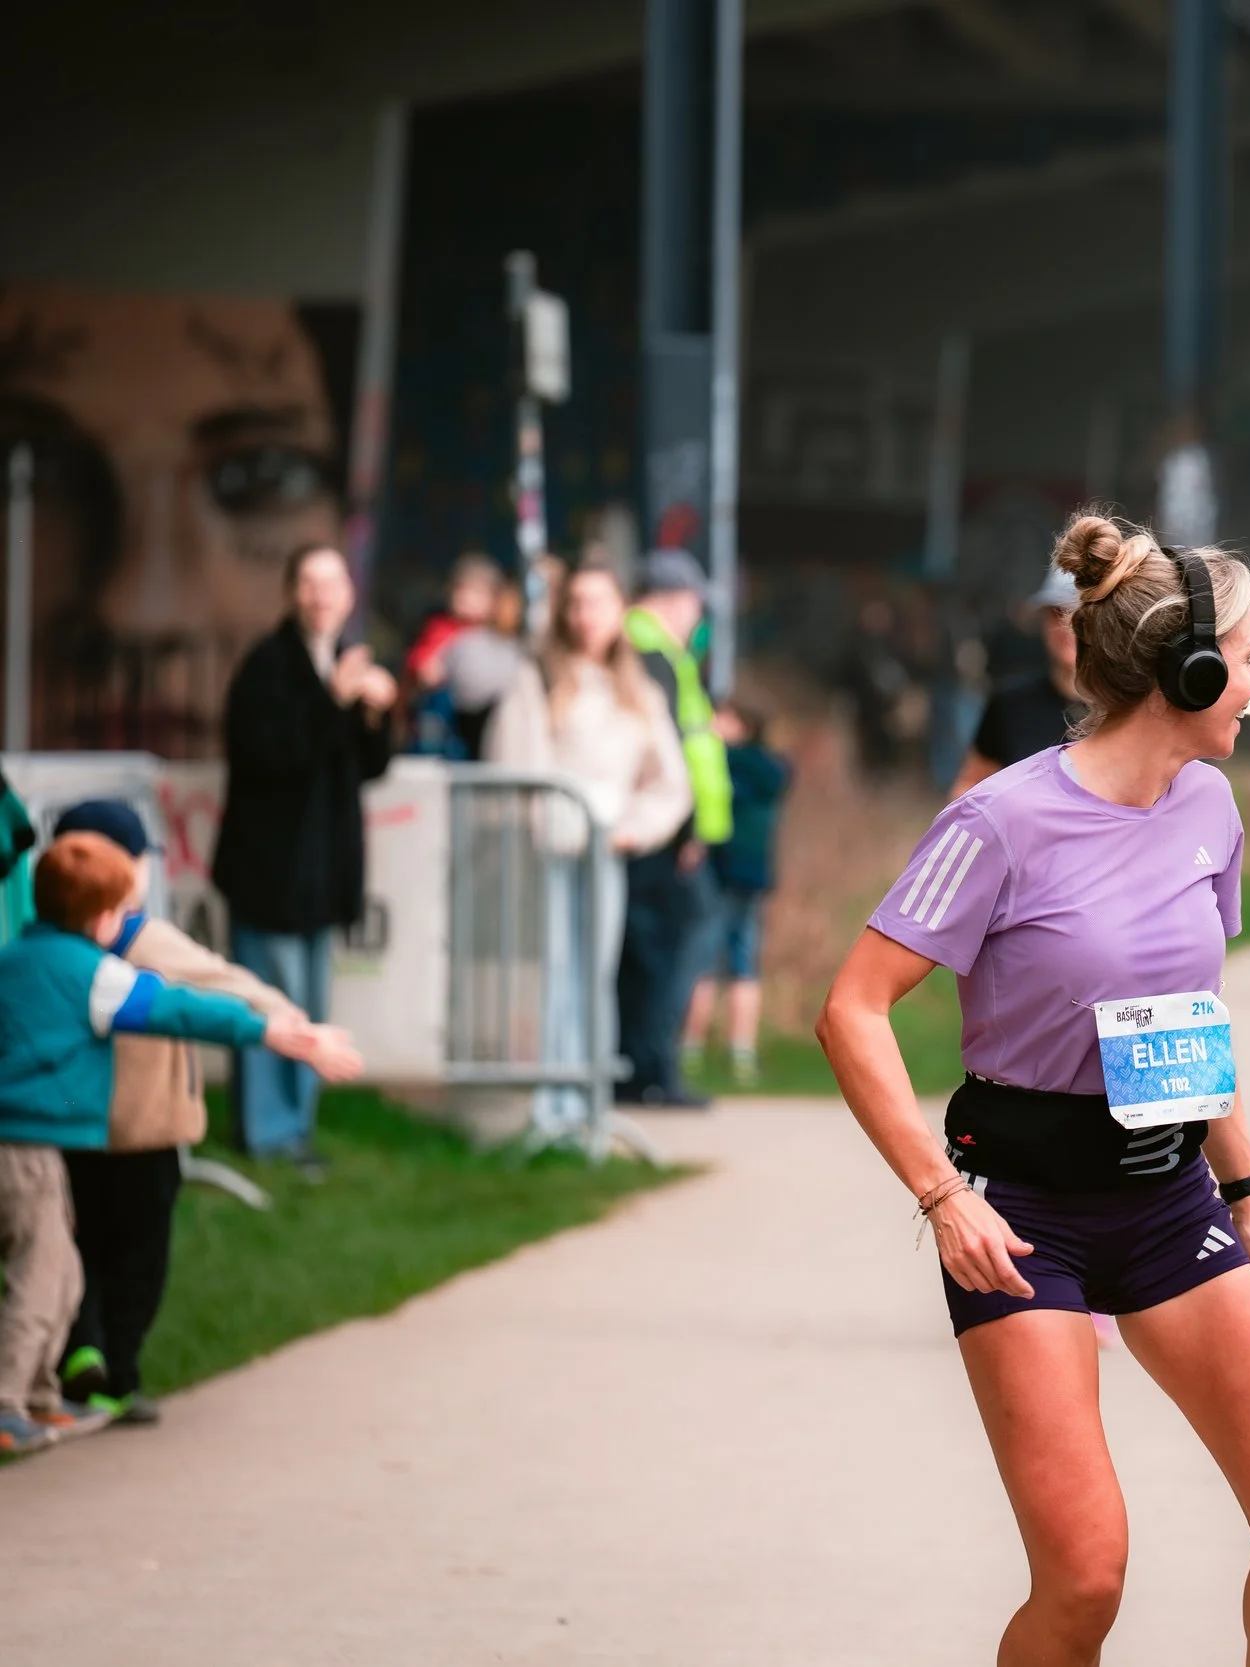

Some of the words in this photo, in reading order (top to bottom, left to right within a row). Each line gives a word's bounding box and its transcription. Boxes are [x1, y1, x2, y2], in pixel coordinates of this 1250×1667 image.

[1192, 1001, 1215, 1016] 21K
[1132, 1037, 1208, 1069] ELLEN
[1161, 1077, 1191, 1093] 1702
